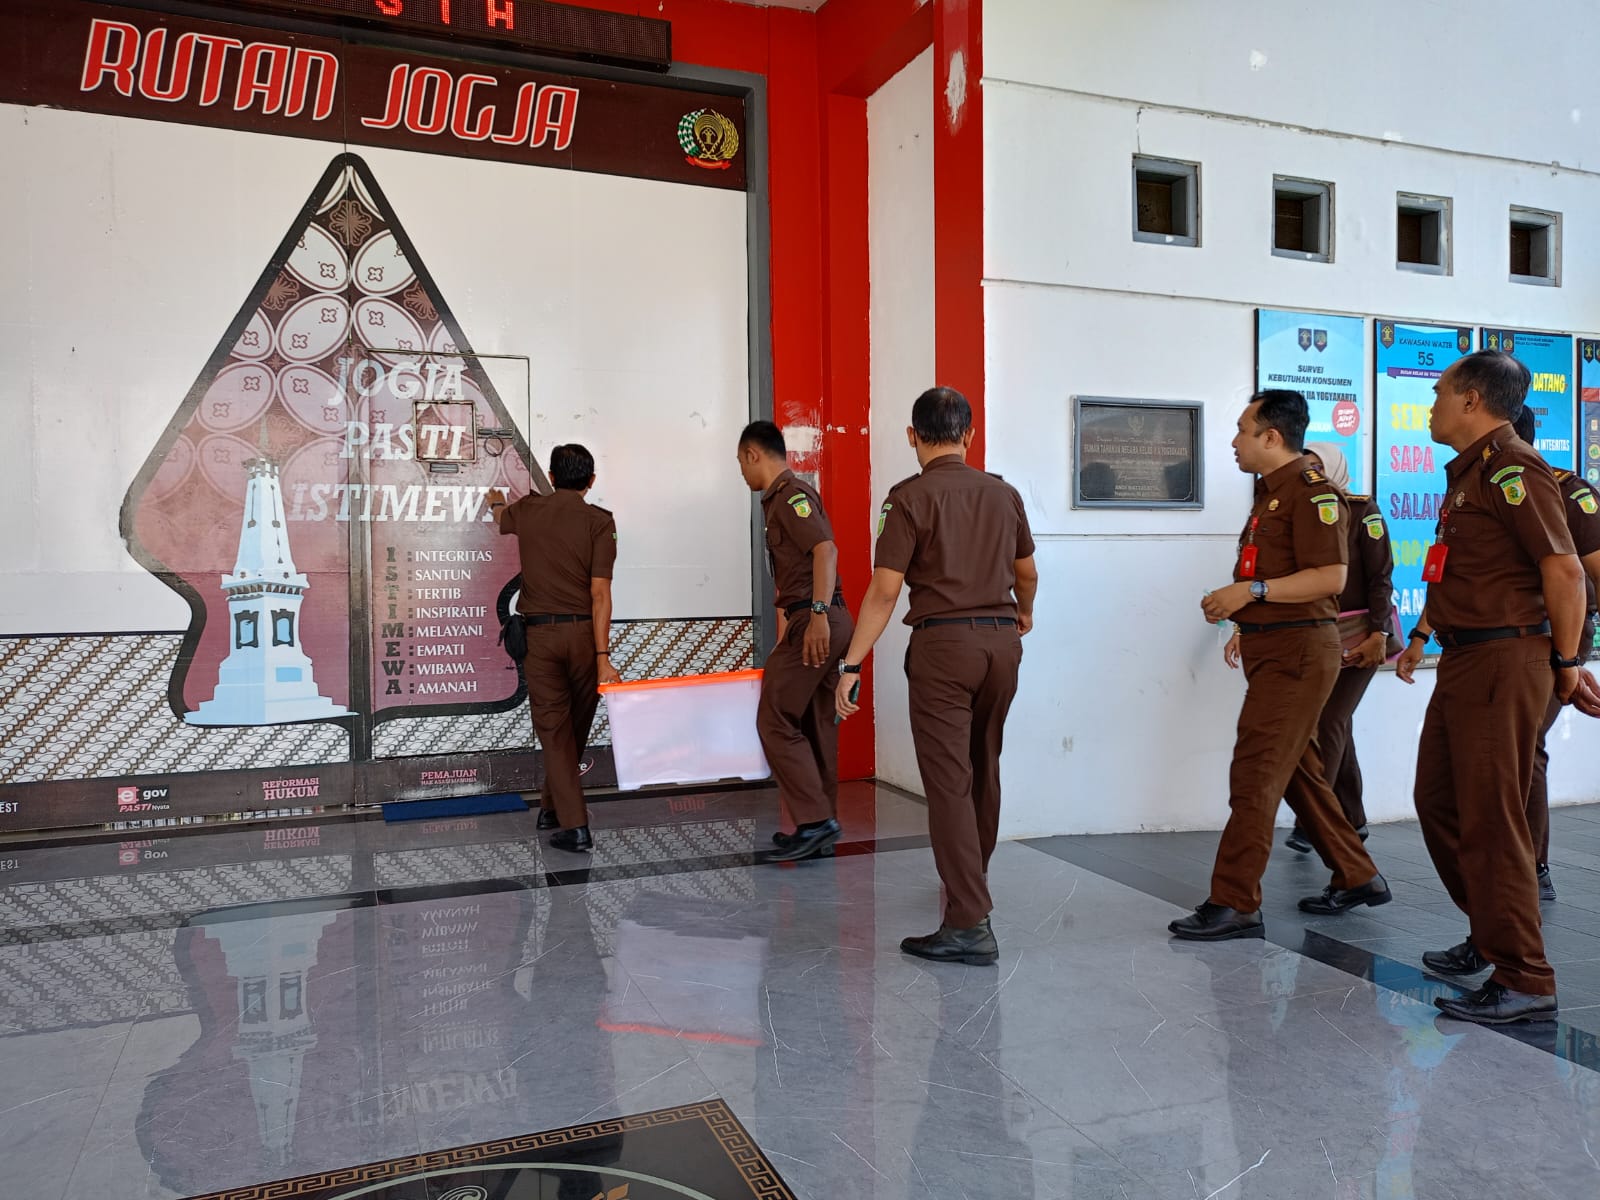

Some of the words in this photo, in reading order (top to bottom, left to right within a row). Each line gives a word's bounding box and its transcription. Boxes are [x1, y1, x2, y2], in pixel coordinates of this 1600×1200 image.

[80, 18, 339, 121] RUTAN
[361, 63, 580, 150] JOGJA
[1399, 338, 1431, 347] KAWASAN
[1418, 351, 1435, 366] 5S
[1298, 364, 1324, 374] SURVEI
[1268, 373, 1312, 384] KEBUTUHAN
[1312, 377, 1353, 387] KONSUMEN
[1533, 372, 1566, 394] DATANG
[339, 421, 467, 460] PASTI
[1540, 439, 1570, 452] INTEGRITAS
[1390, 445, 1435, 473] SAPA
[415, 550, 493, 562] INTEGRITAS
[415, 569, 471, 581] SANTUN
[415, 587, 462, 600] TERTIB
[416, 605, 488, 619] INSPIRATIF
[416, 624, 483, 638] MELAYANI
[416, 643, 465, 657] EMPATI
[416, 662, 475, 675] WIBAWA
[416, 681, 478, 694] AMANAH
[421, 768, 478, 780] PEMAJUAN
[262, 777, 319, 789] REFORMASI
[143, 788, 168, 800] gov
[264, 786, 319, 800] HUKUM
[120, 803, 152, 812] PASTI
